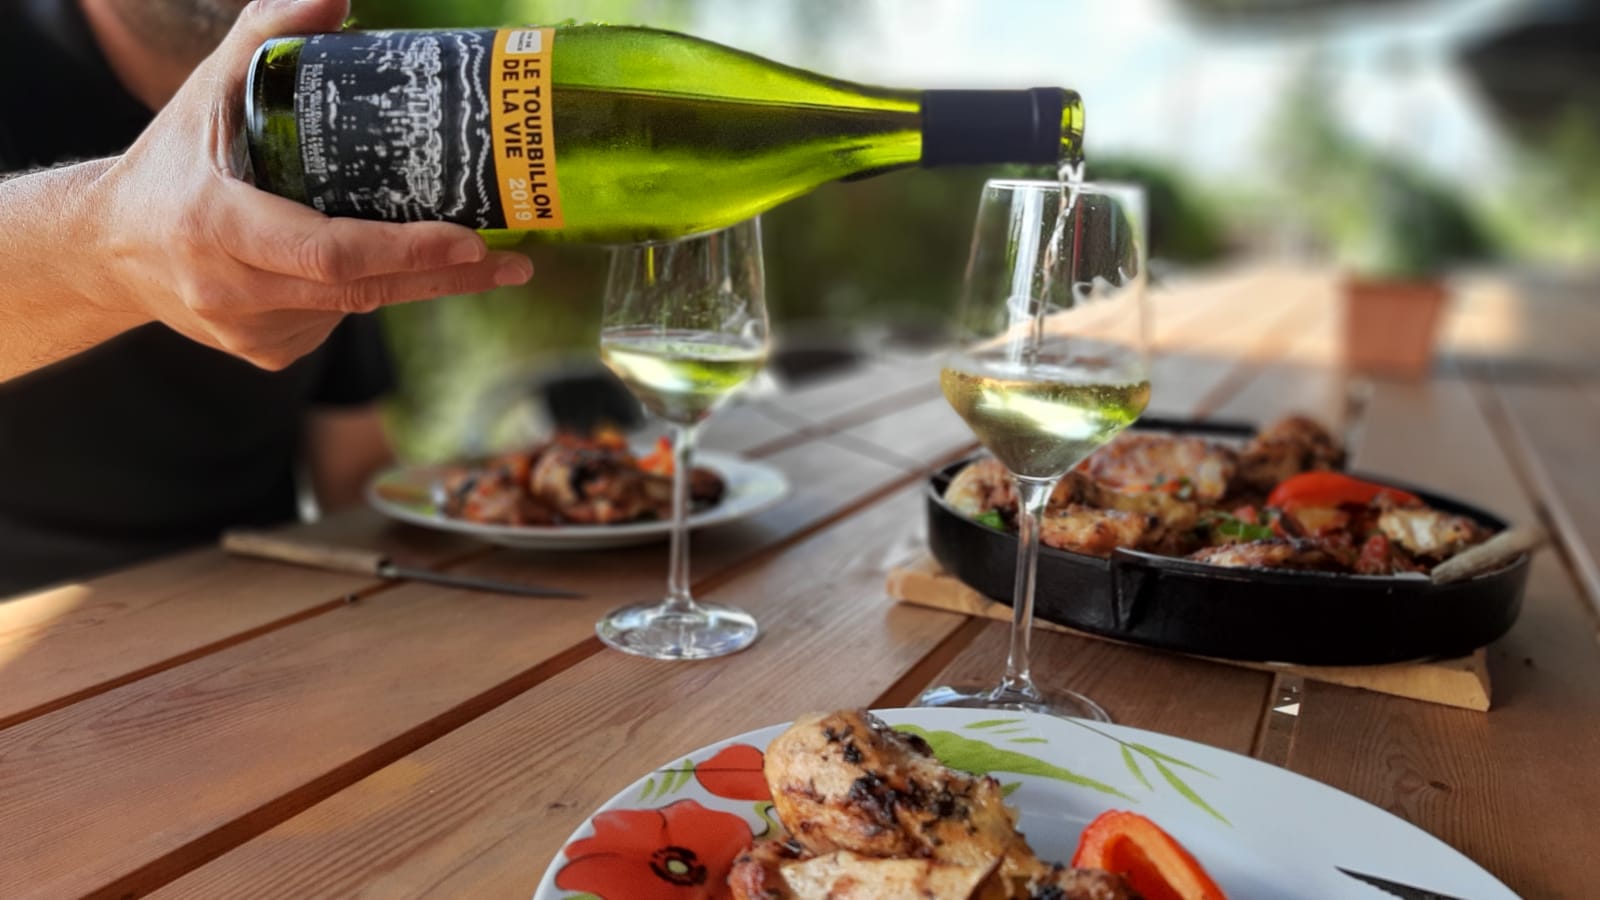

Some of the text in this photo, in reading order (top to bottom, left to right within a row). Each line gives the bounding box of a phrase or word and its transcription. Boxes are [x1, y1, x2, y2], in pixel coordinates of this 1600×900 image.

[503, 59, 523, 158] DE LA VIE
[524, 59, 553, 219] LE TOURBILLON
[509, 177, 533, 220] 2019
